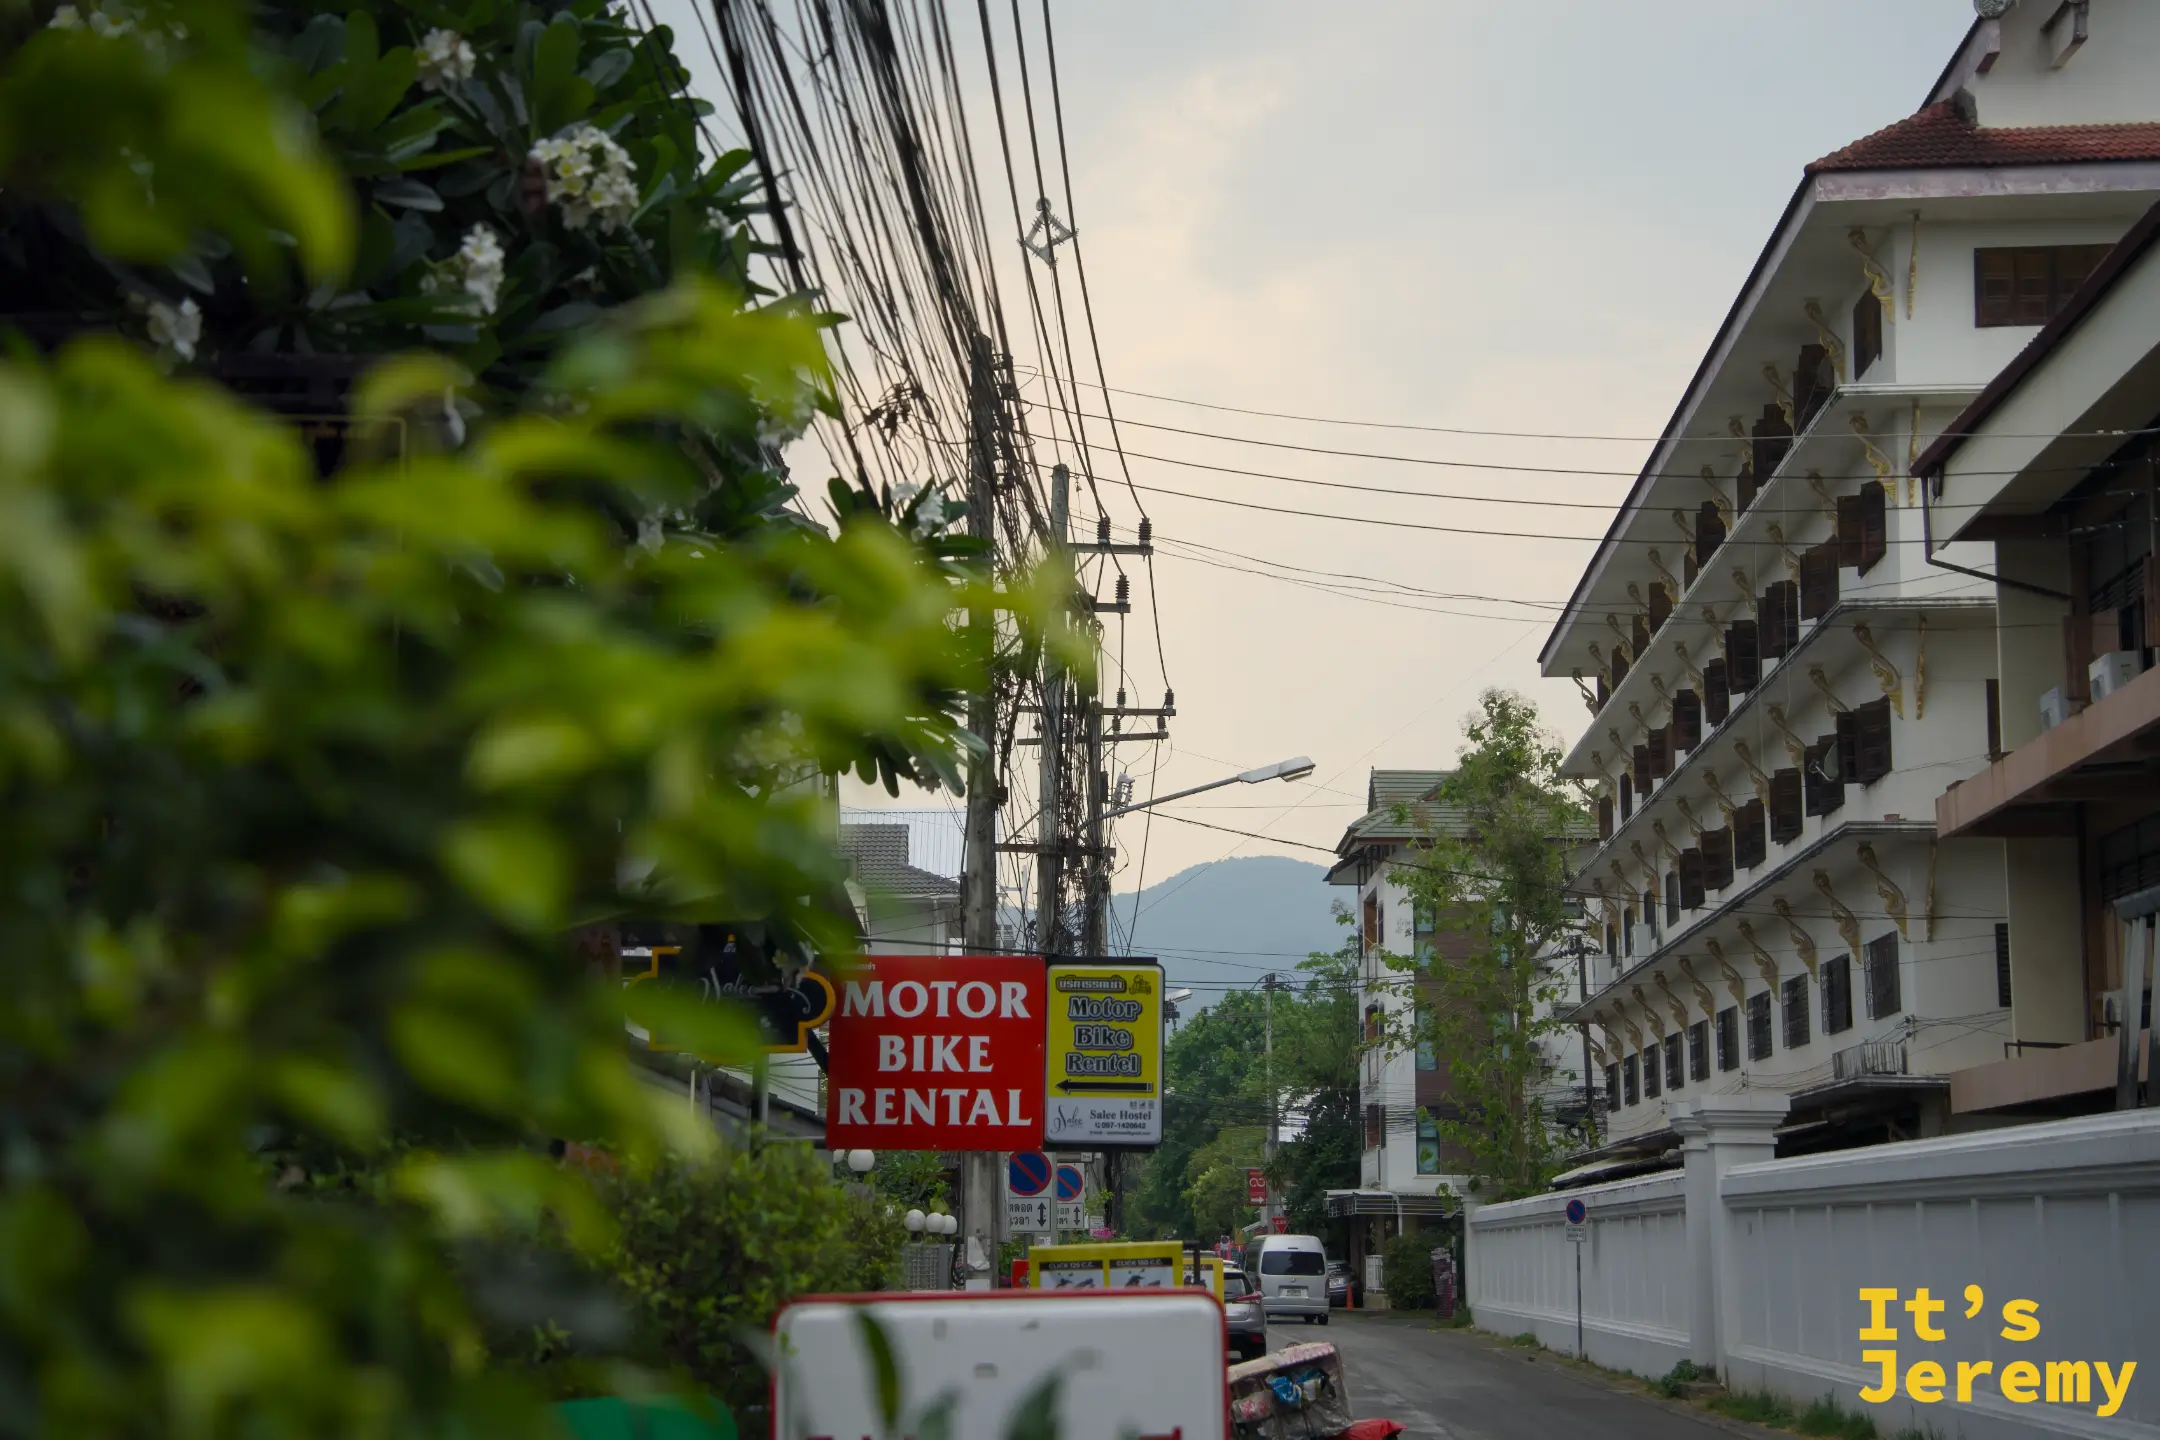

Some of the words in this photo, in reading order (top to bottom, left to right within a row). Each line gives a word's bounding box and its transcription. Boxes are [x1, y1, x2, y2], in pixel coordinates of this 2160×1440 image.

[842, 980, 1031, 1019] MOTOR
[1069, 996, 1141, 1020] Motor
[1074, 1026, 1132, 1049] Bike
[877, 1034, 995, 1073] BIKE
[1067, 1053, 1140, 1075] Rentel
[837, 1087, 1033, 1127] RENTAL
[1089, 1109, 1117, 1120] Salee
[1119, 1109, 1152, 1121] Hostel
